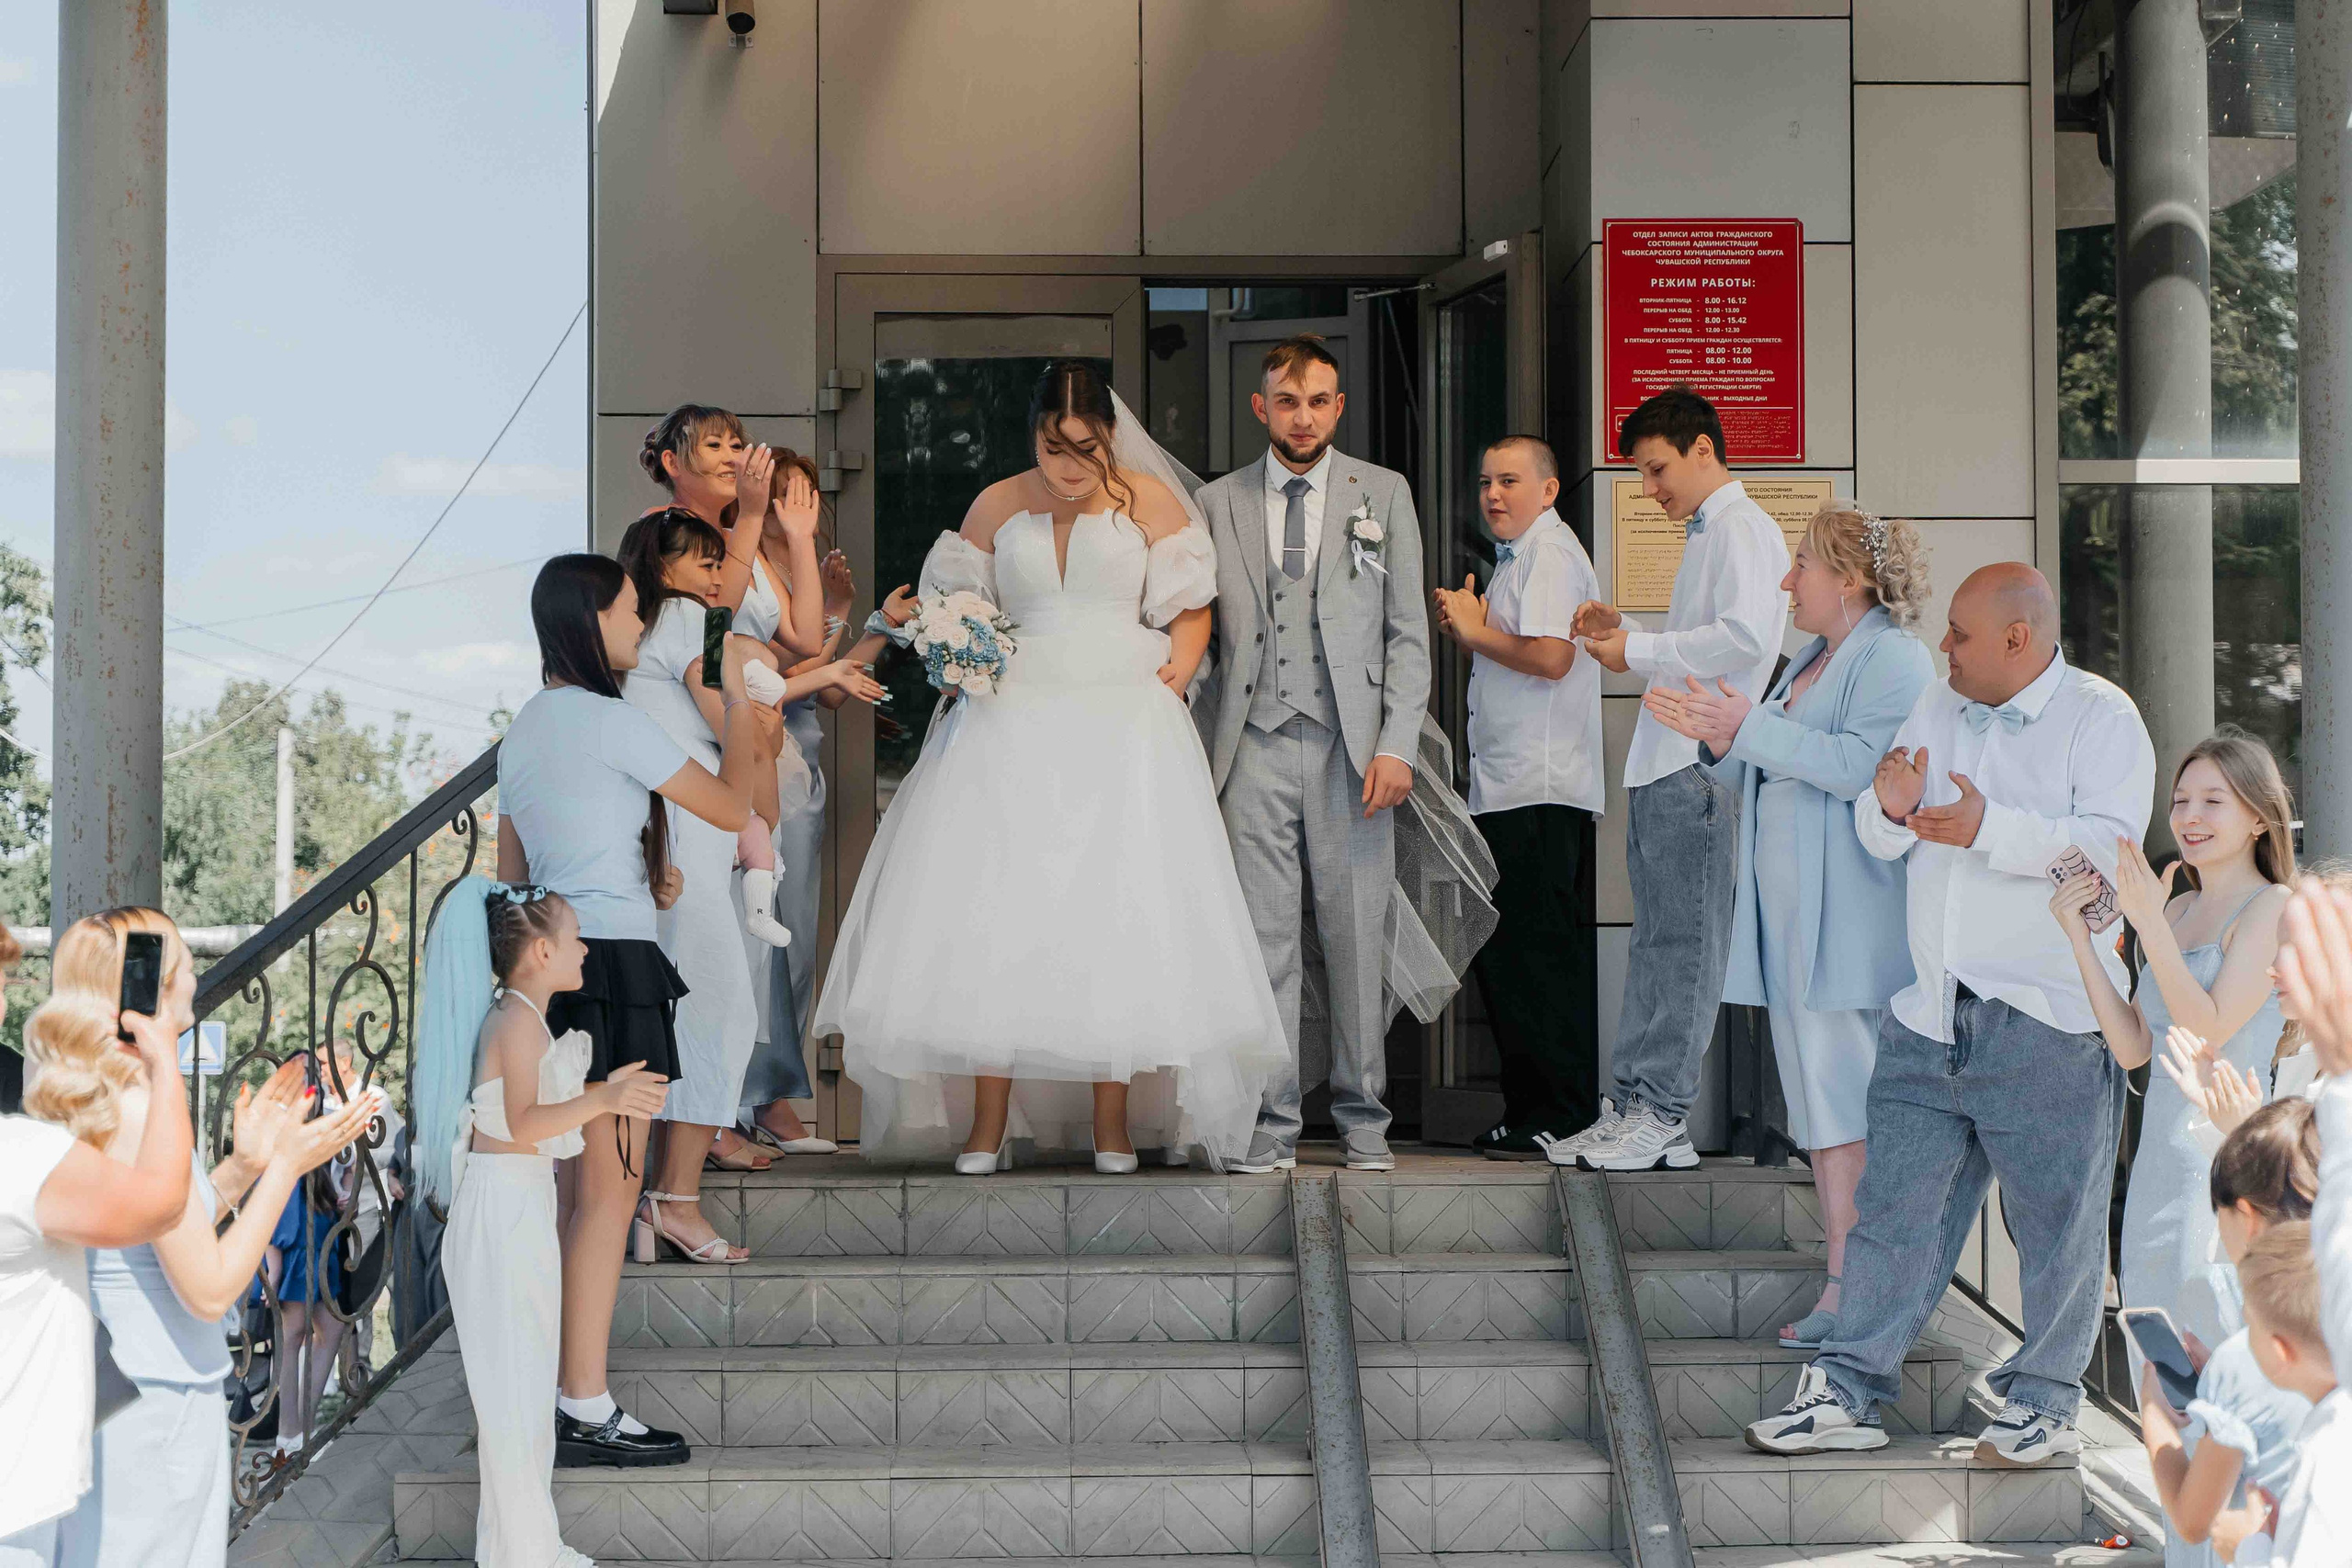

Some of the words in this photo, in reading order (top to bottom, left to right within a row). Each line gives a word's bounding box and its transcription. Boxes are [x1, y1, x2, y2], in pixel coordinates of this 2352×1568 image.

[1633, 231, 1656, 239] ОТДЕЛ
[1716, 231, 1773, 239] ГРАЖДАНСКОГО
[1692, 240, 1758, 248] АДМИНИСТРАЦИИ
[1684, 249, 1755, 257] МУНИЦИПАЛЬНОГО
[1656, 257, 1702, 265] ЧУВАШСКОЙ
[1651, 277, 1697, 288] РЕЖИМ
[1702, 277, 1756, 288] РАБОТЫ:
[1704, 297, 1721, 305] 8.00
[1727, 297, 1747, 305] 16.12
[1704, 316, 1721, 324] 8.00
[1727, 316, 1747, 324] 15.42
[1705, 346, 1726, 355] 08.00
[1732, 346, 1752, 355] 12.00
[1705, 356, 1726, 365] 08.00
[1732, 356, 1752, 365] 10.00
